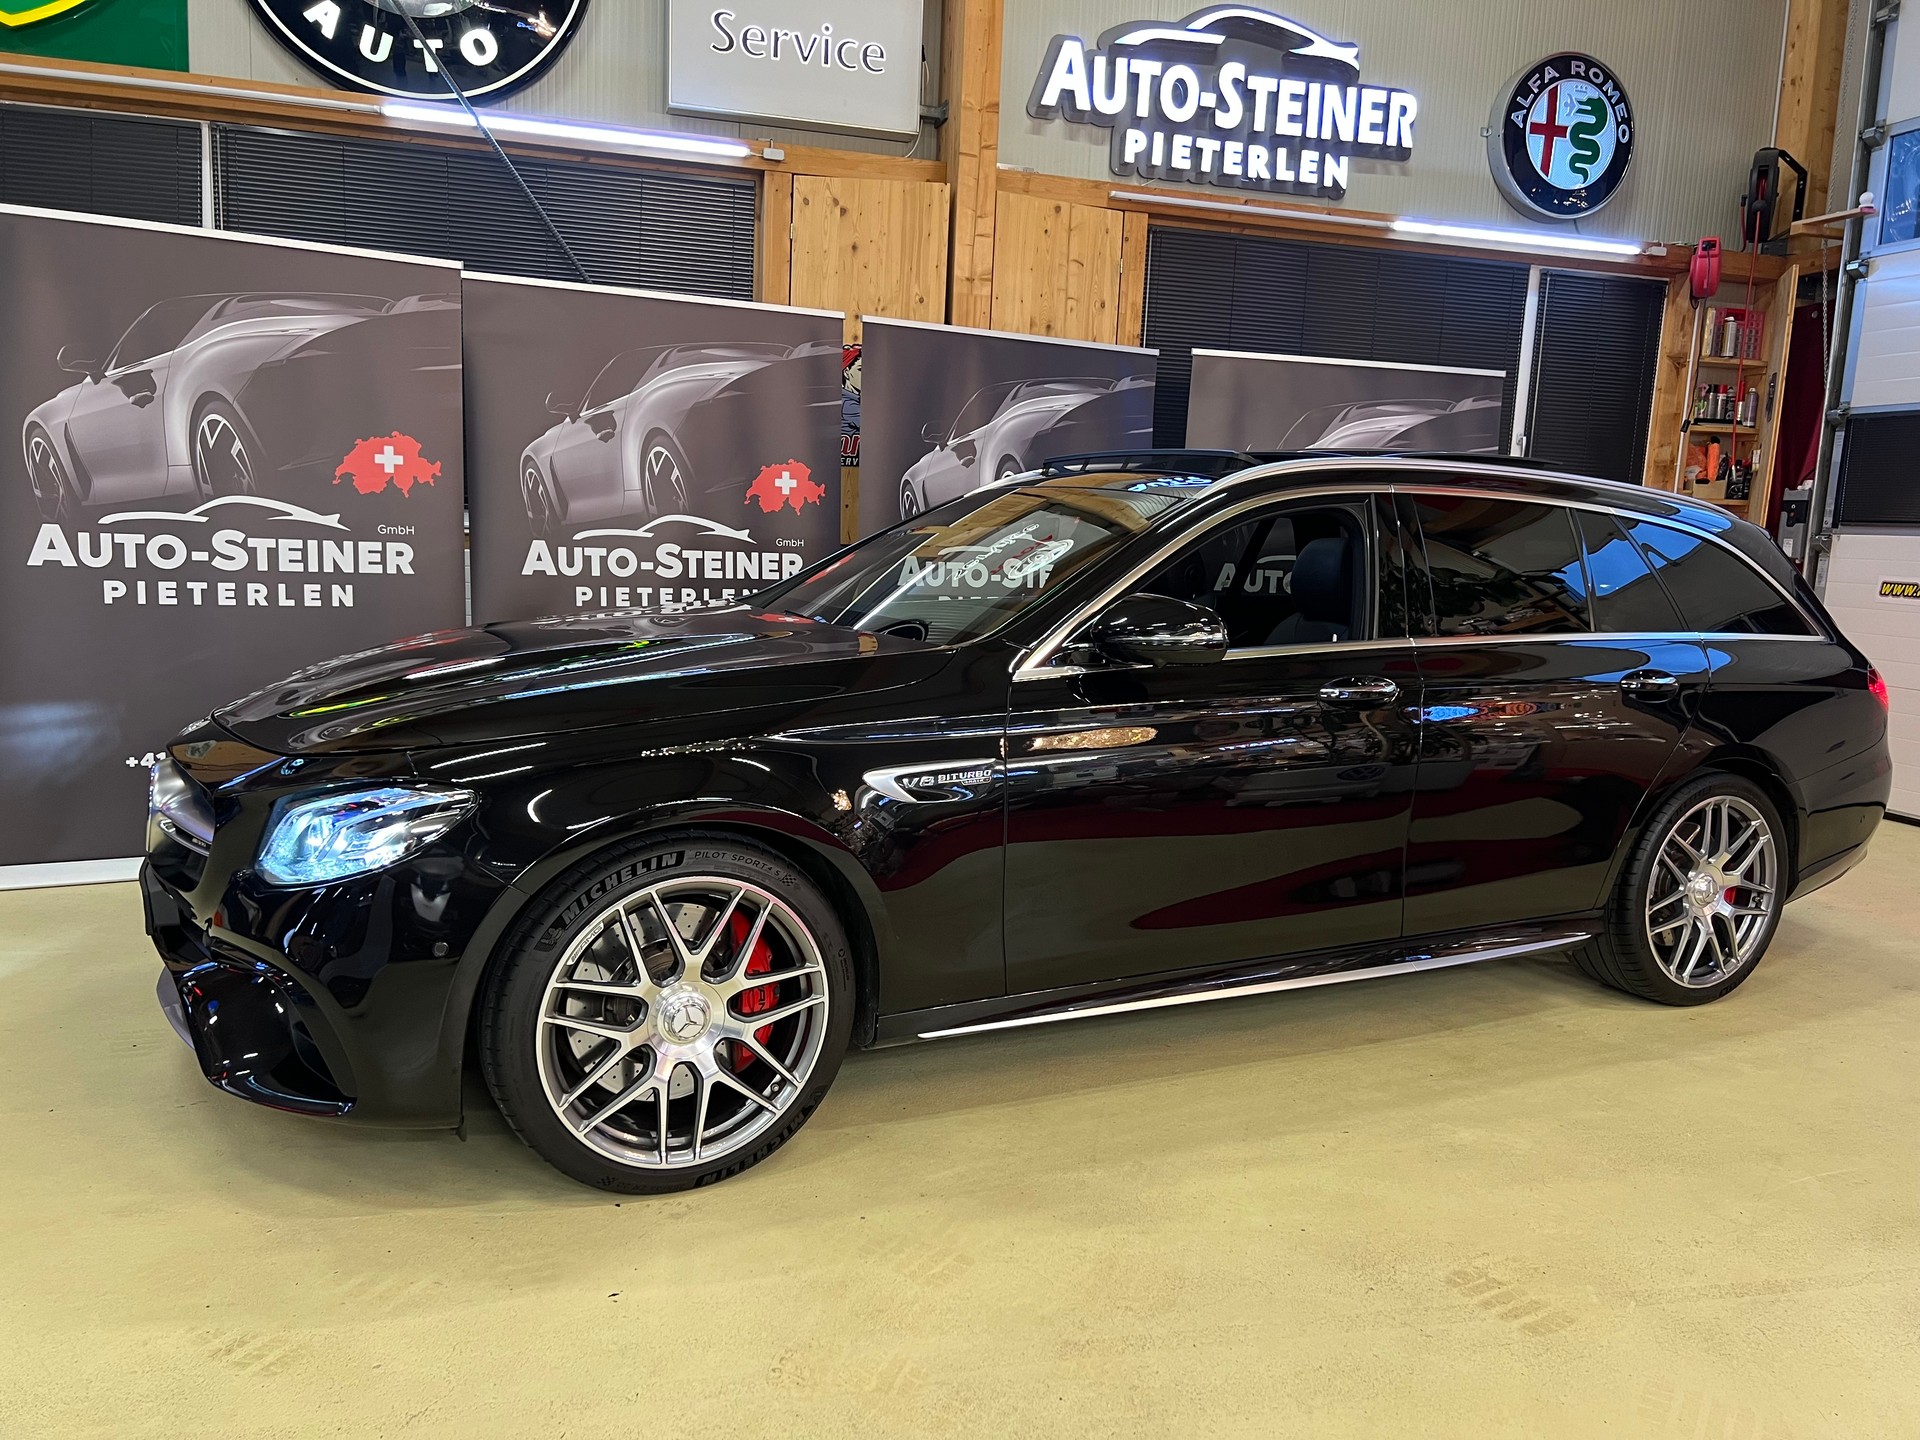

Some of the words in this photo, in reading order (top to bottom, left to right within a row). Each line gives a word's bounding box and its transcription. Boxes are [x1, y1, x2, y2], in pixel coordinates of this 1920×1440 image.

[303, 0, 498, 73] AUTO
[709, 9, 887, 75] Service
[1040, 39, 1418, 148] AUTO-STEINER
[1511, 65, 1560, 129] ALFA
[1570, 60, 1630, 144] ROMEO
[1124, 128, 1349, 190] PIETERLEN
[27, 523, 415, 575] AUTO-STEINER
[377, 524, 415, 536] GmbH
[775, 538, 804, 547] GmbH
[521, 539, 804, 581] AUTO-STEINER
[103, 580, 354, 607] PIETERLEN
[1881, 583, 1920, 597] www.
[902, 775, 935, 788] V8
[938, 769, 992, 782] BITURBO
[694, 851, 727, 859] PILOT
[731, 854, 770, 870] SPORT
[562, 852, 678, 926] MICHELIN
